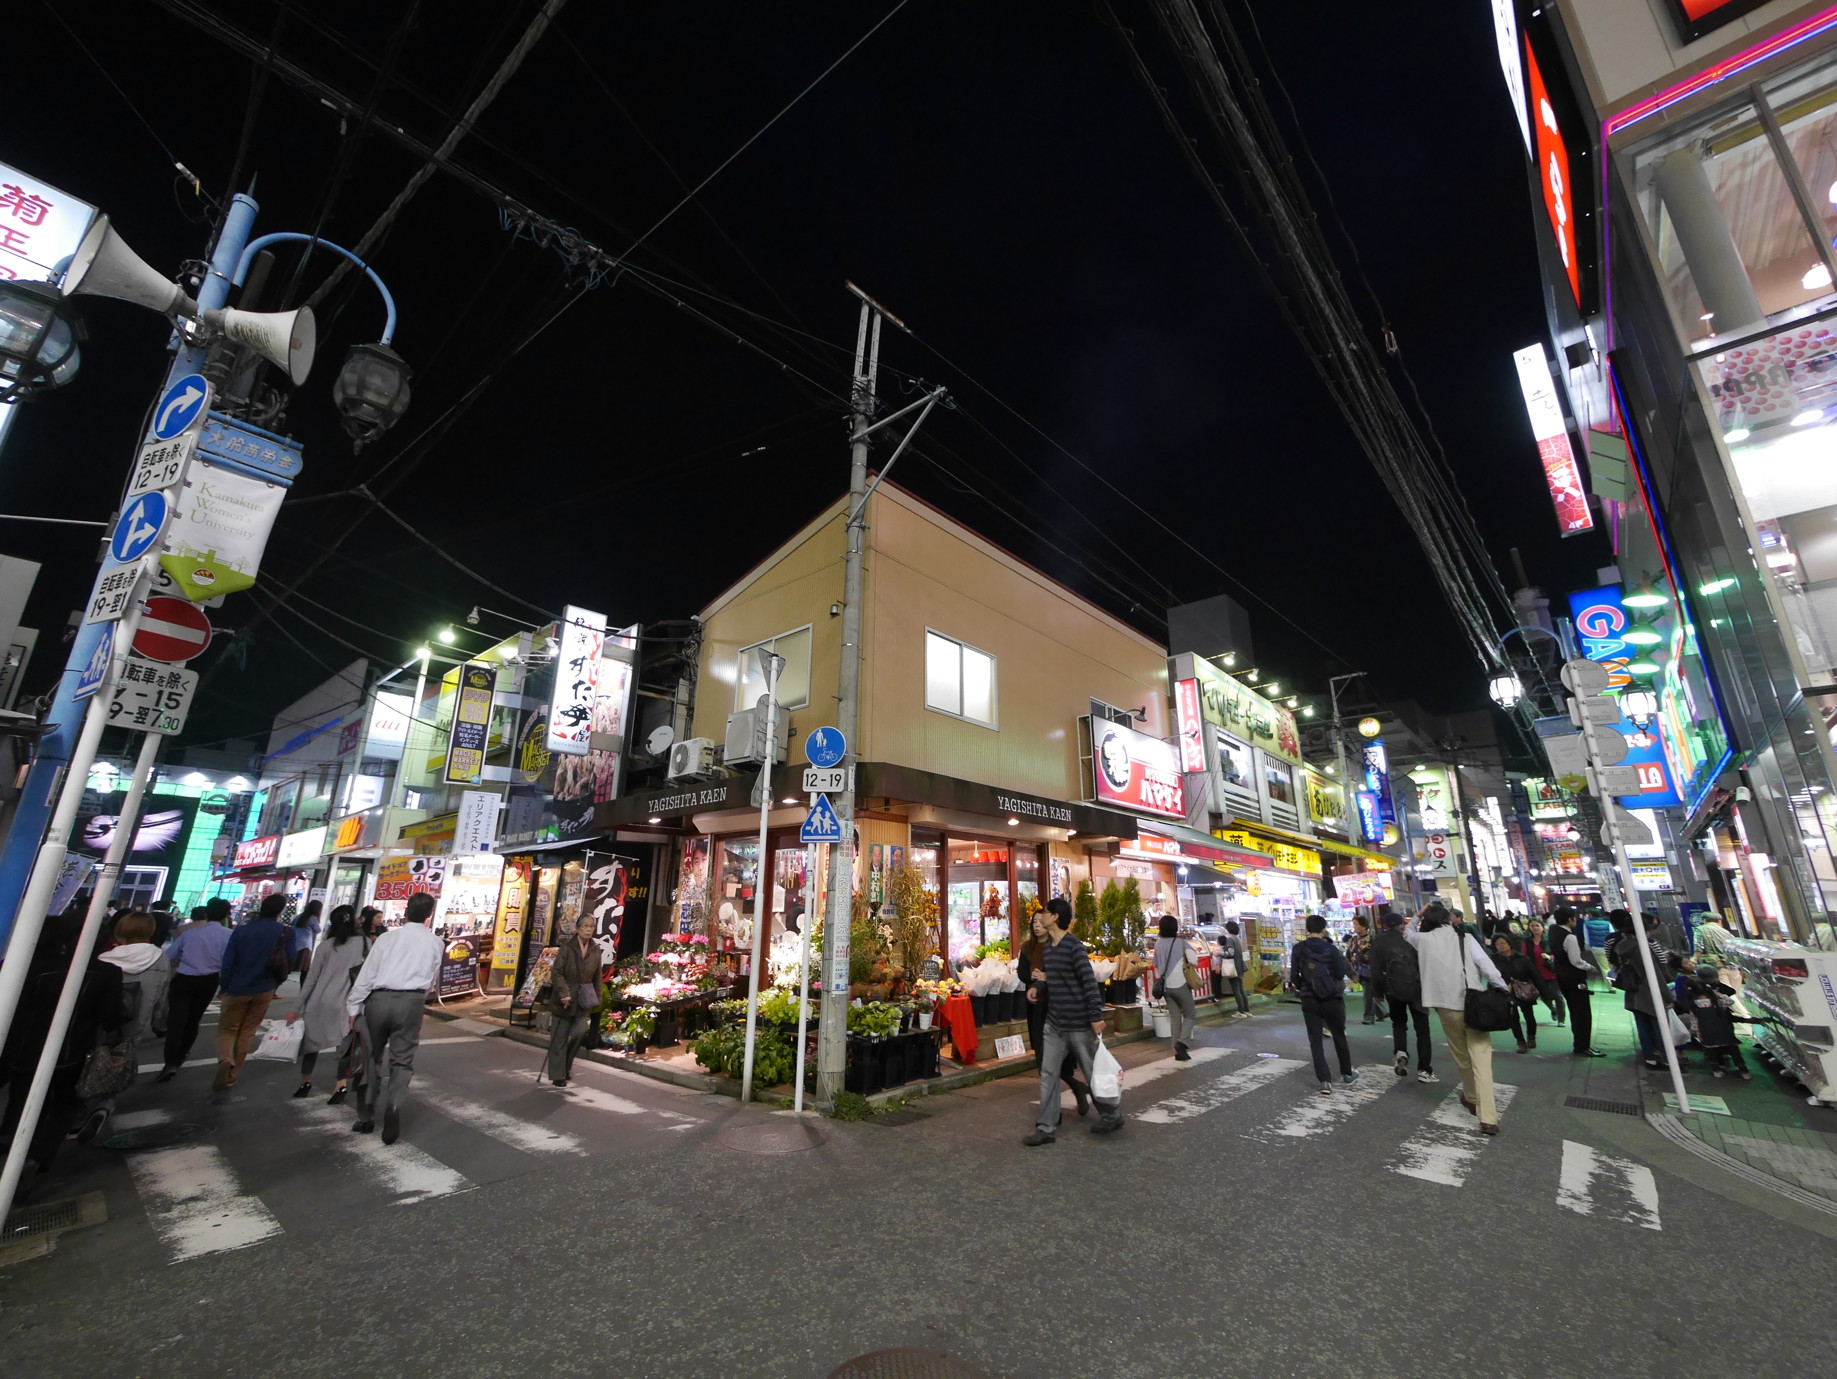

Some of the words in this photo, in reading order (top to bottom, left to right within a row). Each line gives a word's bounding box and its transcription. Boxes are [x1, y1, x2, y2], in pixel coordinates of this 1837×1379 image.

[134, 462, 179, 490] 12-19
[200, 481, 265, 513] Kamakura
[190, 509, 256, 541] University
[119, 663, 191, 693] 転車を除く
[375, 720, 400, 732] au
[805, 772, 842, 788] 12-19
[648, 792, 697, 813] YAGISHITA
[699, 786, 727, 805] KAEN
[997, 795, 1049, 818] YAGISHITA
[1049, 806, 1072, 822] KAEN
[1140, 779, 1183, 812] ハマケイ
[470, 795, 486, 851] エリアクエスト
[376, 881, 430, 900] 3500
